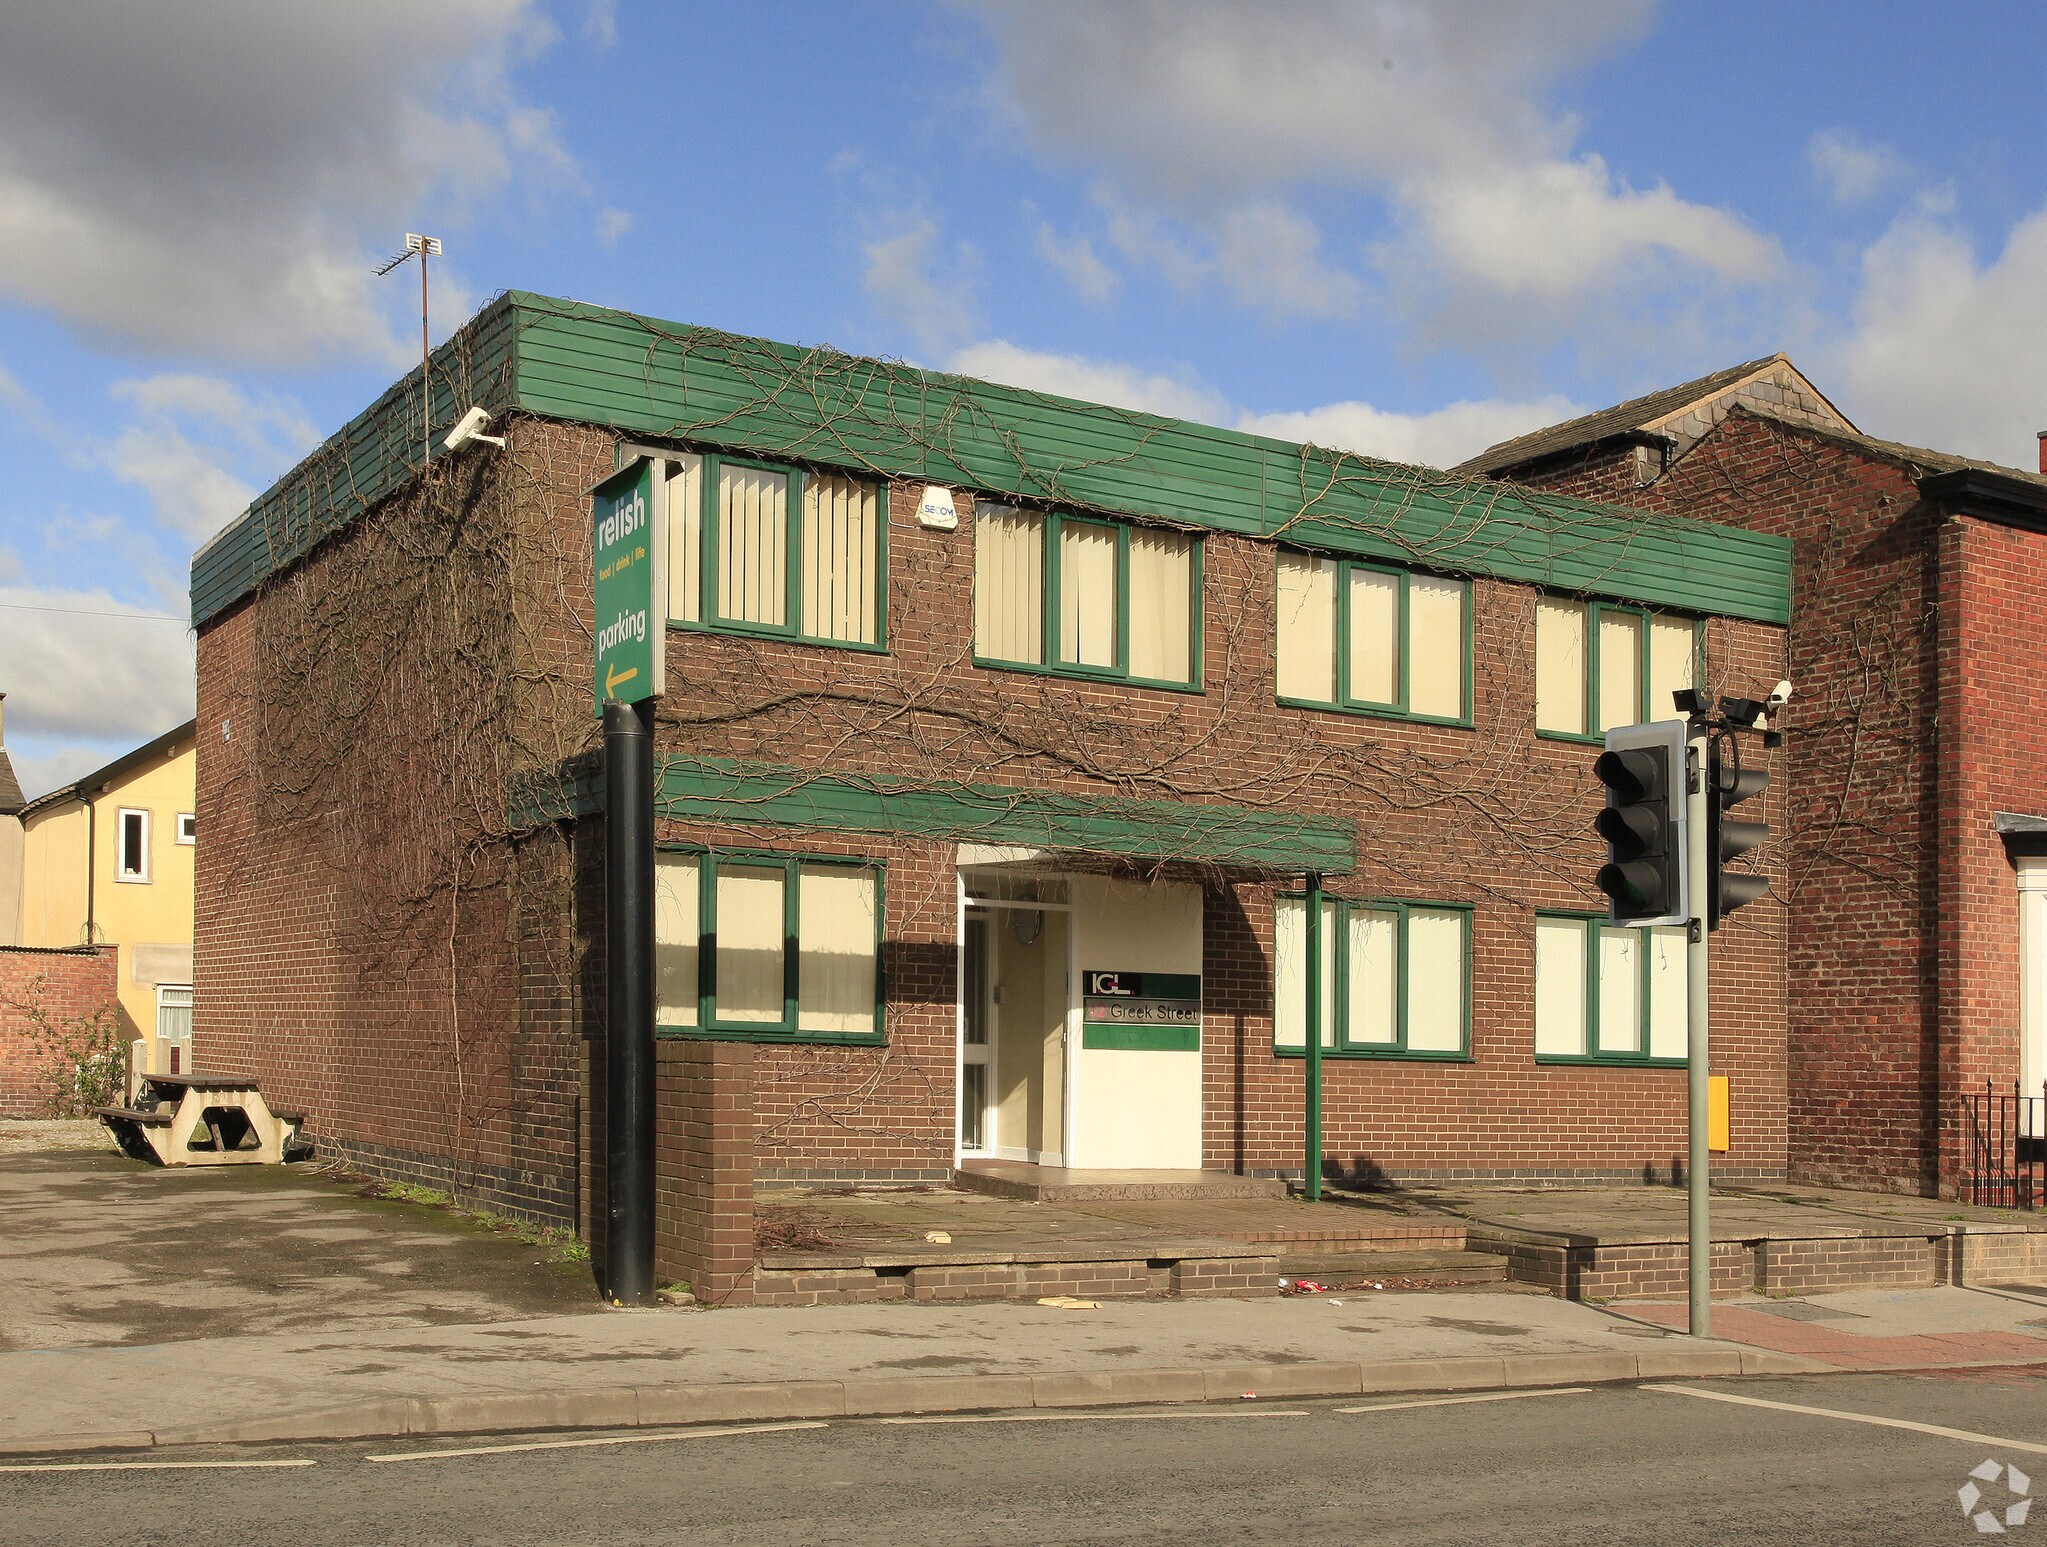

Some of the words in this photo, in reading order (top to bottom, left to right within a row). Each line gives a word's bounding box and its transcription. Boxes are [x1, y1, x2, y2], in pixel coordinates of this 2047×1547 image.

[598, 488, 645, 551] relish
[924, 504, 954, 517] SECOM
[599, 565, 612, 581] food
[615, 553, 630, 572] drink
[635, 546, 645, 560] life
[598, 608, 646, 661] parking
[1110, 1003, 1153, 1018] Greek
[1156, 1004, 1197, 1020] Street
